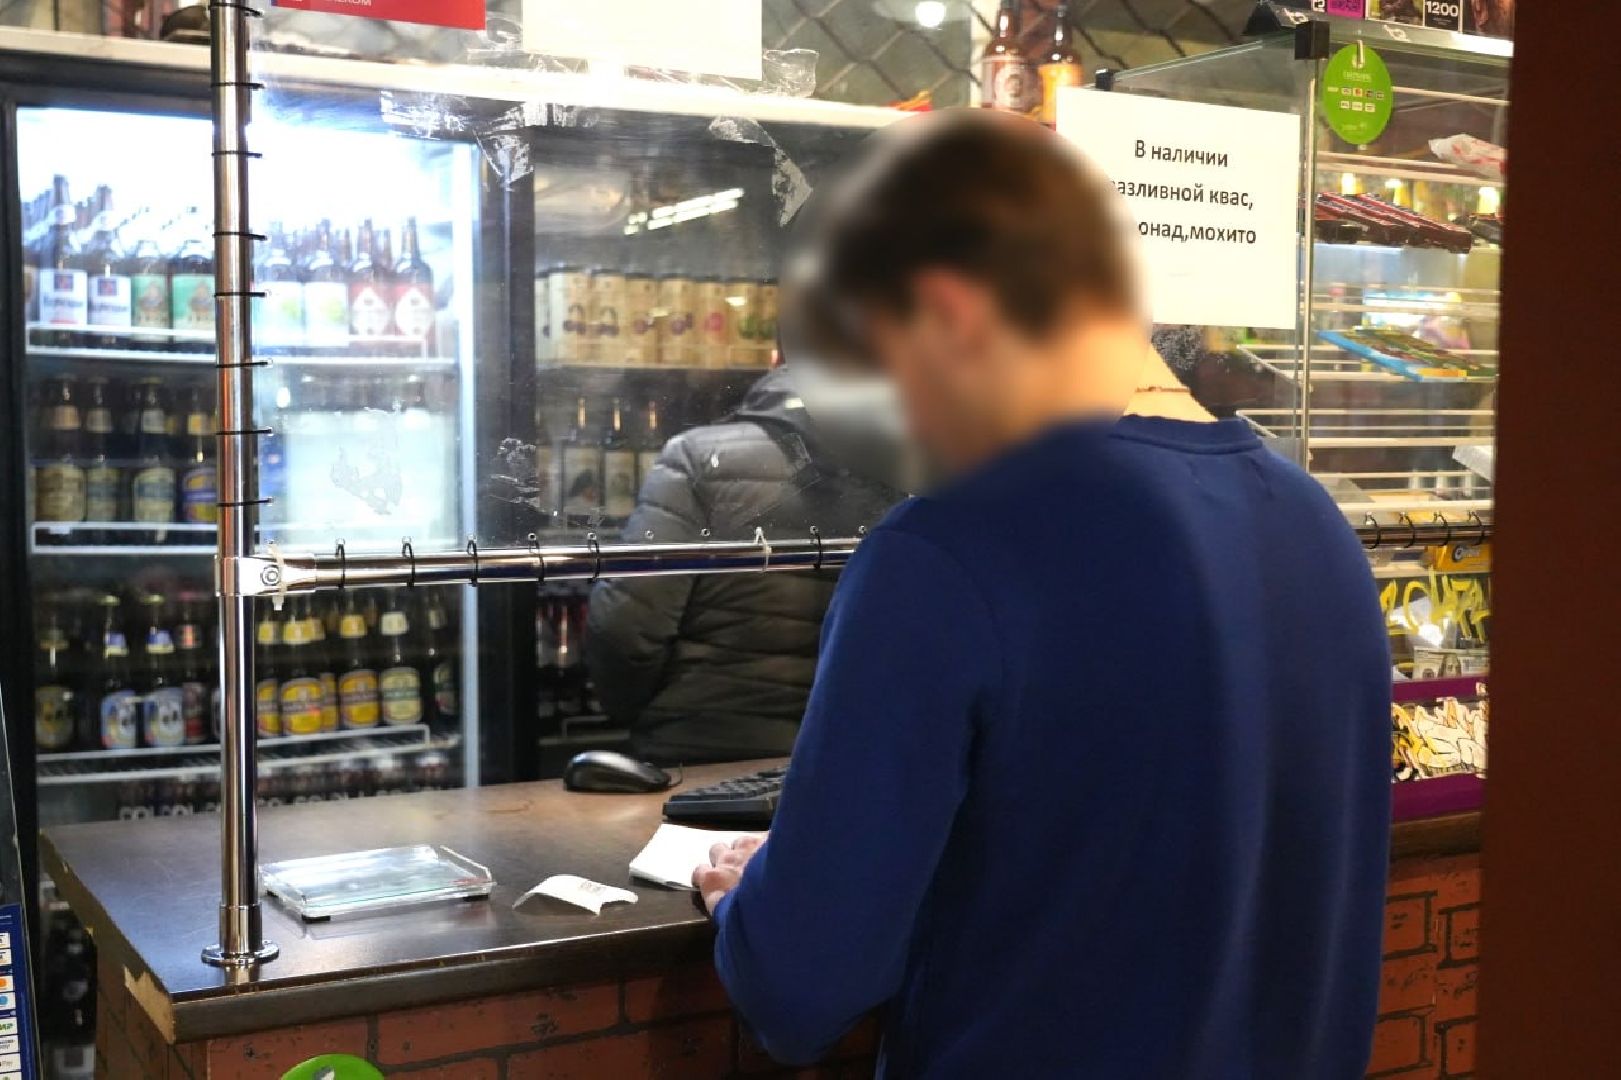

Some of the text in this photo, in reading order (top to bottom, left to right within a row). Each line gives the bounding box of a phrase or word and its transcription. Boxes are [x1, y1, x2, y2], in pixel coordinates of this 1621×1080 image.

[1425, 1, 1458, 17] 1200
[1134, 140, 1228, 168] В наличии
[1110, 180, 1253, 211] азливной квас,
[1138, 221, 1257, 244] онад,мохито
